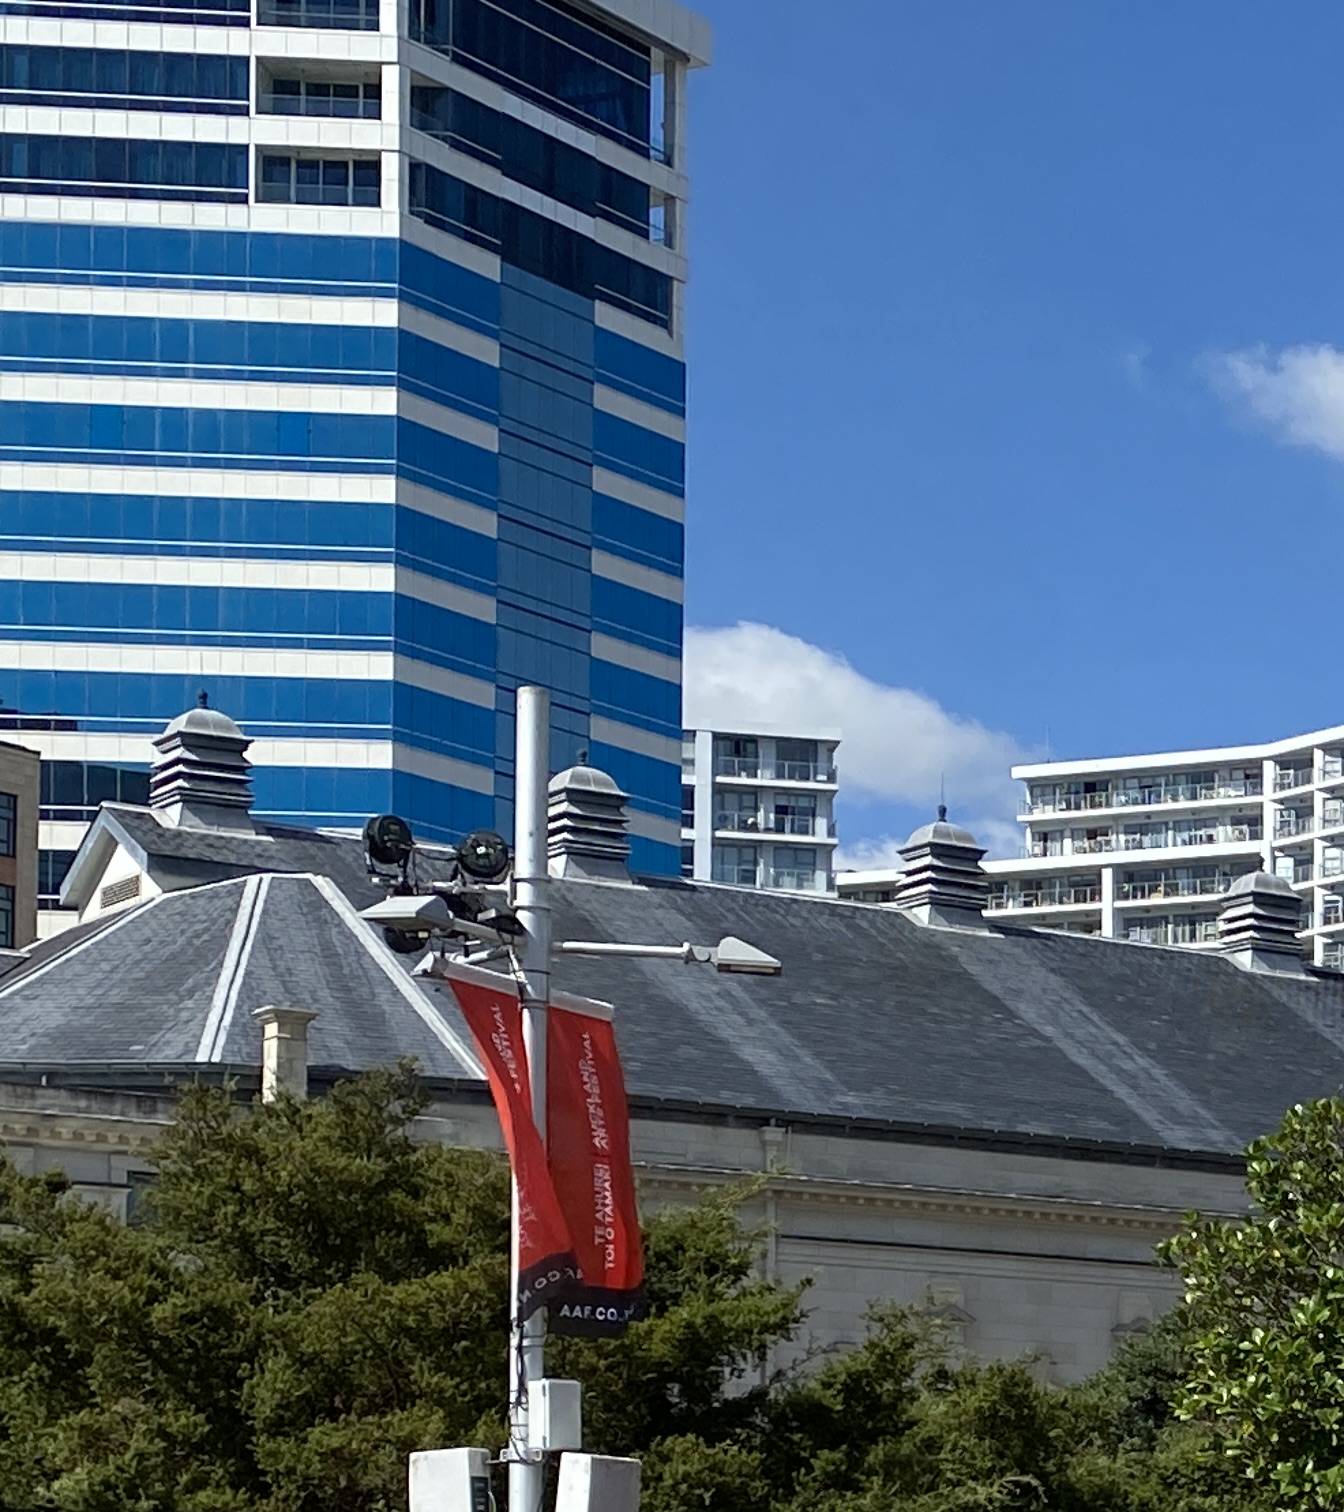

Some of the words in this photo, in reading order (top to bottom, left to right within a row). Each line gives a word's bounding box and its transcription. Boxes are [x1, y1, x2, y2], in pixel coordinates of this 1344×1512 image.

[593, 1224, 606, 1246] TE
[604, 1226, 615, 1241] O
[604, 1243, 615, 1270] TOI
